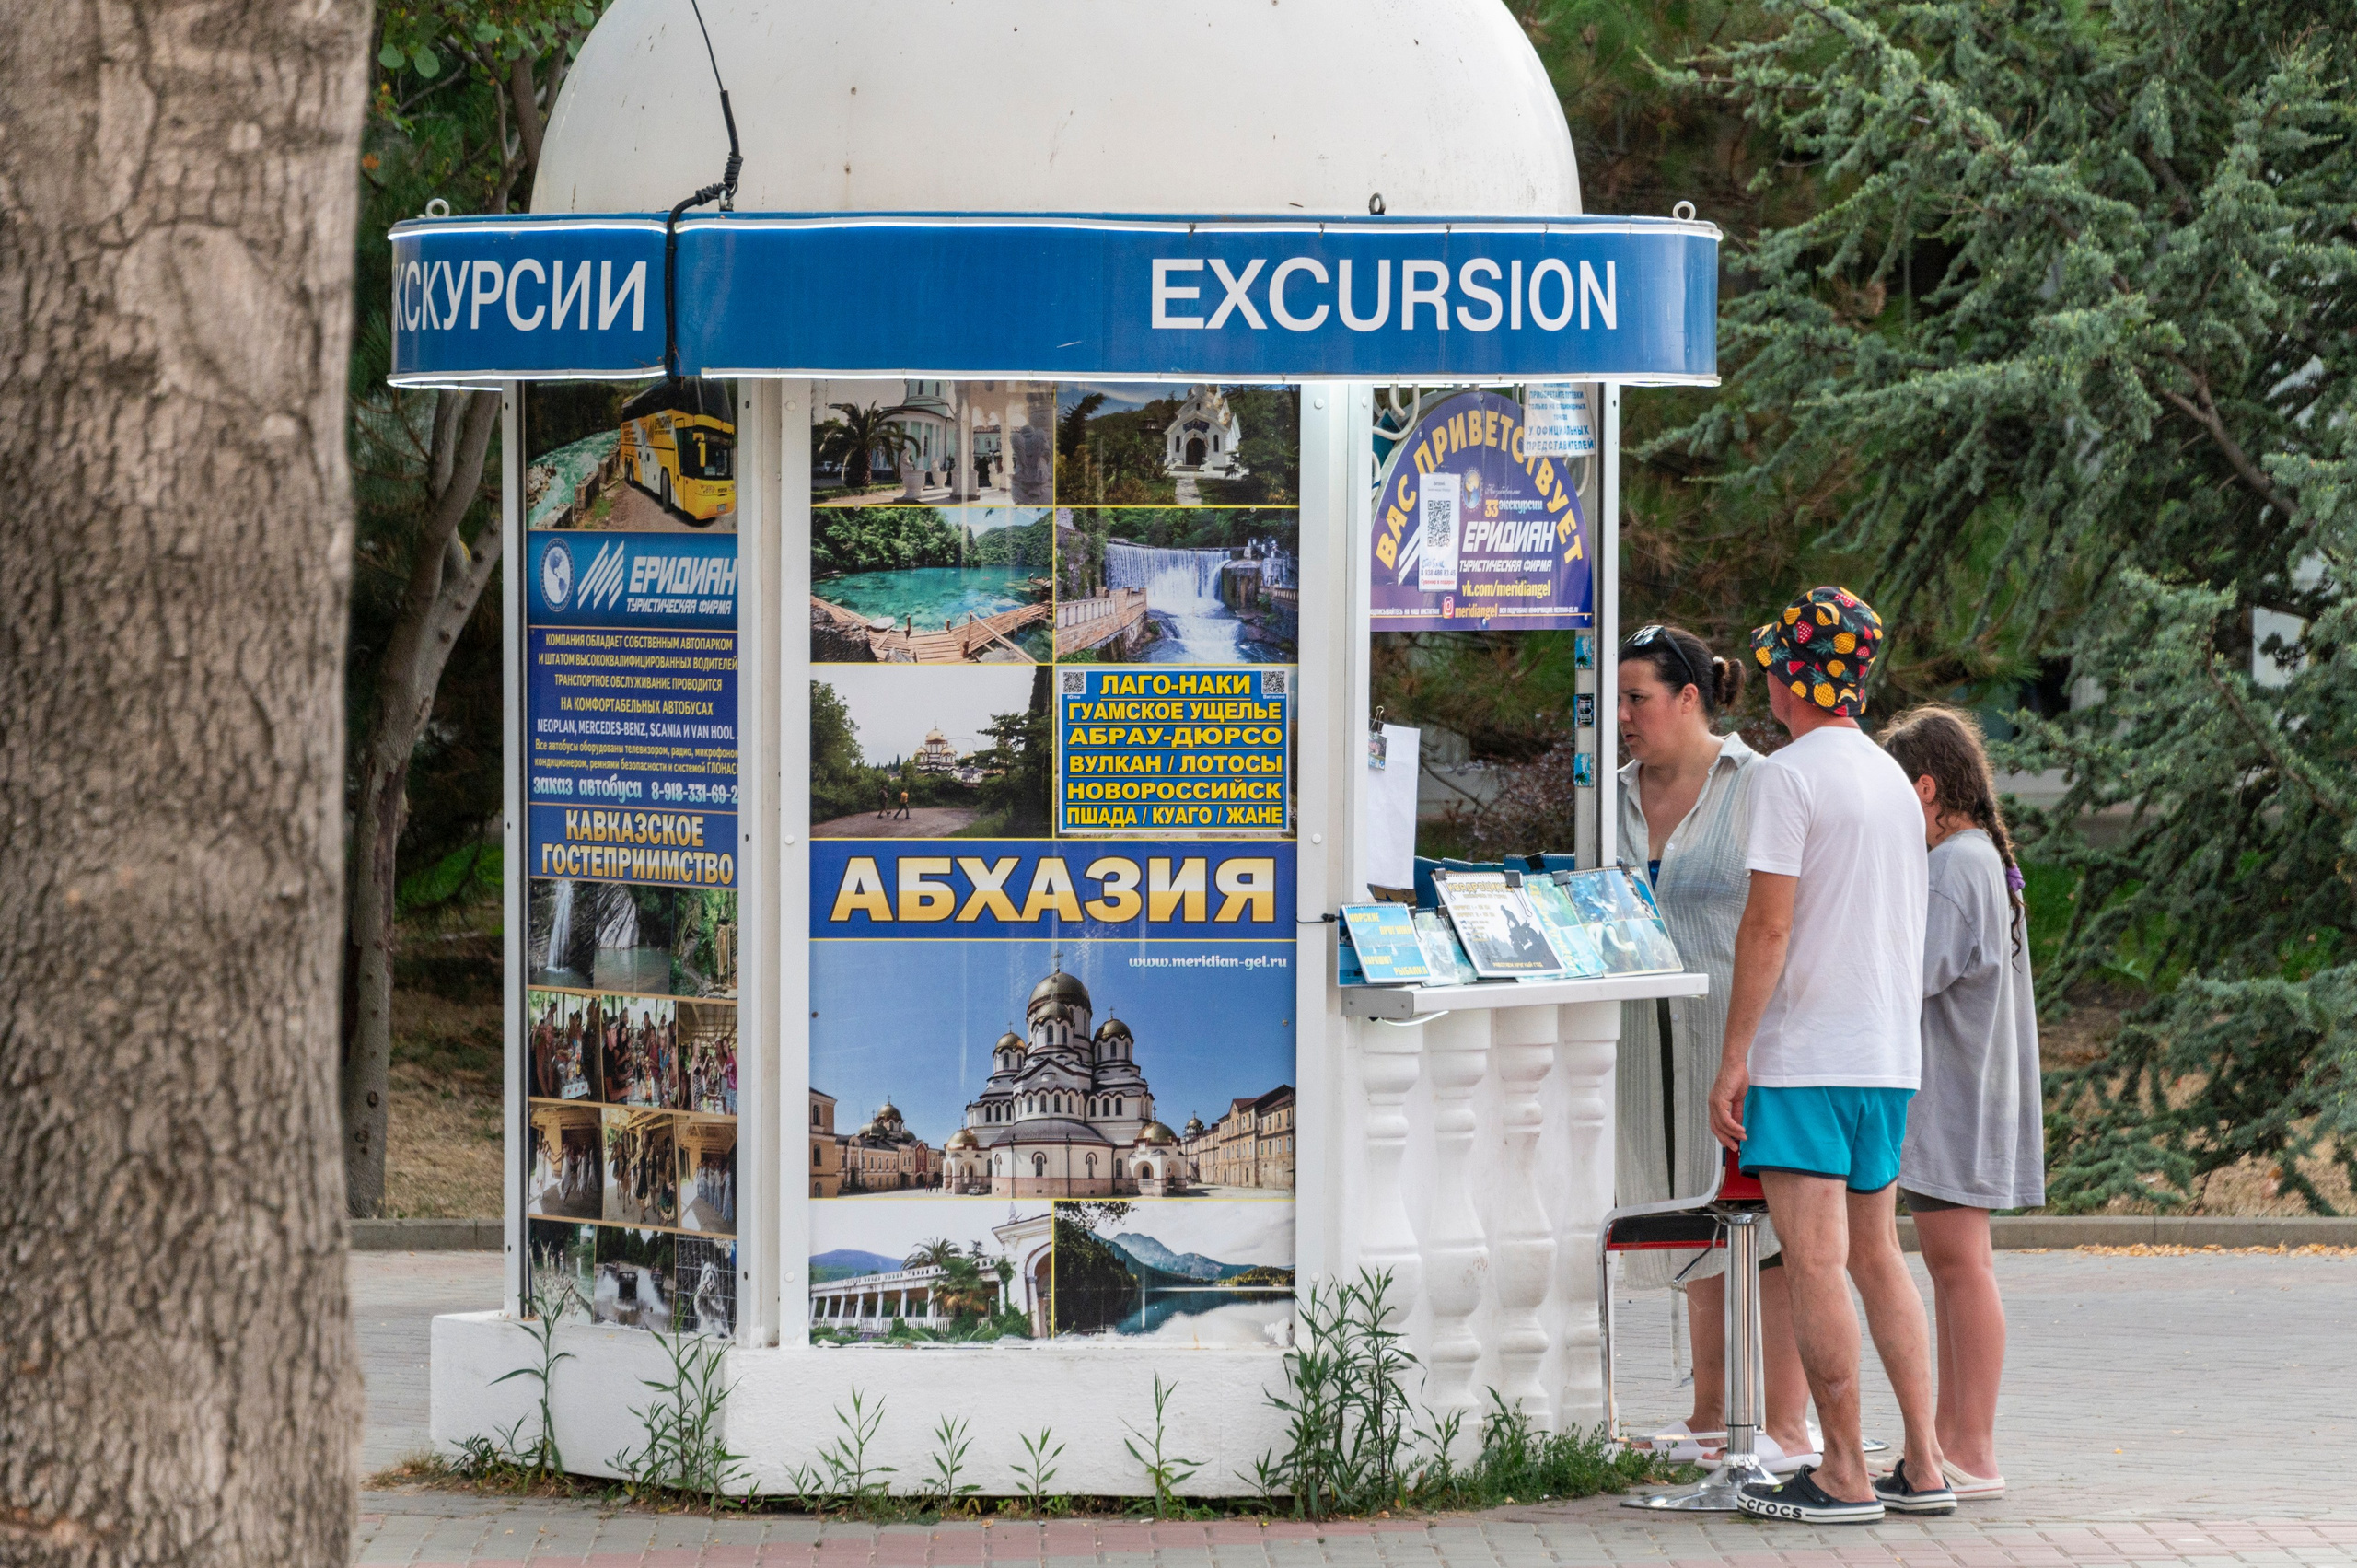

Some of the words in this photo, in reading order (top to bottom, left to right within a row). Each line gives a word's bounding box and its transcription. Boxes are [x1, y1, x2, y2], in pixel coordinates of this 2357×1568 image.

[392, 258, 647, 332] КСКУРСИИ
[1151, 256, 1618, 332] EXCURSION
[1528, 425, 1534, 436] У
[1536, 424, 1590, 437] ОФИЦИАЛЬНЫХ
[1526, 437, 1595, 452] ПРЕДСТАВИТЕЛЕЙ
[1484, 499, 1499, 517] 33
[1499, 499, 1543, 514] экскурсии
[1376, 474, 1417, 570] ВАС
[1462, 521, 1557, 552] ЕРИДИАН
[1459, 559, 1522, 572] ТУРИСТИЧЕСКАЯ
[1524, 559, 1552, 572] ФИРМА
[1462, 580, 1551, 598] vk.com/meridiangel
[626, 598, 696, 614] ТУРИСТИЧЕСКАЯ
[698, 599, 732, 615] ФИРМА
[1455, 603, 1498, 620] meridiangel
[545, 633, 585, 646] КОМПАНИЯ
[586, 635, 623, 649] ОБЛАДАЕТ
[624, 635, 679, 650] СОБСТВЕННЫМ
[679, 637, 733, 651] АВТОПАРКОМ
[538, 653, 544, 664] И
[545, 653, 575, 666] ШТАТОМ
[575, 654, 691, 670] ВЫСОКОКВАЛИФИЦИРОВАННЫХ
[692, 656, 737, 672] ВОДИТЕЛЕЙ
[554, 674, 610, 688] ТРАНСПОРТНОЕ
[610, 675, 671, 690] ОБСЛУЖИВАНИЕ
[671, 678, 723, 692] ПРОВОДИТСЯ
[1100, 675, 1250, 695] ЛАГО-НАКИ
[561, 697, 573, 711] НА
[574, 697, 661, 714] КОМФОРТАБЕЛЬНЫХ
[662, 700, 714, 715] АВТОБУСАХ
[1068, 702, 1184, 721] ГУАМСКОЕ
[1190, 702, 1282, 724] УЩЕЛЬЕ
[537, 719, 577, 736] NEOPLAN,
[578, 720, 648, 739] MERCEDES-BENZ,
[650, 724, 682, 738] SCANIA
[683, 724, 690, 738] И
[691, 725, 710, 739] VAN
[711, 725, 735, 740] HOOL
[1067, 726, 1283, 749] АБРАУ-ДЮРСО
[535, 738, 547, 750] Все
[548, 740, 579, 754] автобусы
[579, 740, 624, 755] оборудованы
[625, 744, 670, 758] телевизором,
[670, 747, 693, 760] радио,
[534, 758, 588, 771] кондиционером,
[589, 760, 620, 772] ремнями
[620, 759, 668, 772] безопасности
[668, 763, 673, 772] и
[673, 761, 706, 774] системой
[706, 761, 738, 775] ГЛОНАС
[1069, 755, 1162, 772] ВУЛКАН
[1167, 755, 1175, 772] /
[1178, 755, 1283, 772] ЛОТОСЫ
[533, 776, 573, 796] заказ
[578, 773, 643, 804] автобуса
[1067, 778, 1283, 800] НОВОРОССИЙСК
[1066, 807, 1138, 828] ПШАДА
[1142, 807, 1148, 825] /
[1152, 807, 1212, 825] КУАГО
[1216, 807, 1223, 825] /
[1226, 807, 1283, 825] ЖАНЕ
[565, 809, 705, 848] КАВКАЗСКОЕ
[541, 843, 734, 886] ГОСТЕПРИИМСТВО
[830, 855, 1276, 923] АБХАЗИЯ
[1128, 956, 1287, 970] www.meridian-gel.ru
[1746, 1498, 1803, 1519] crocs
